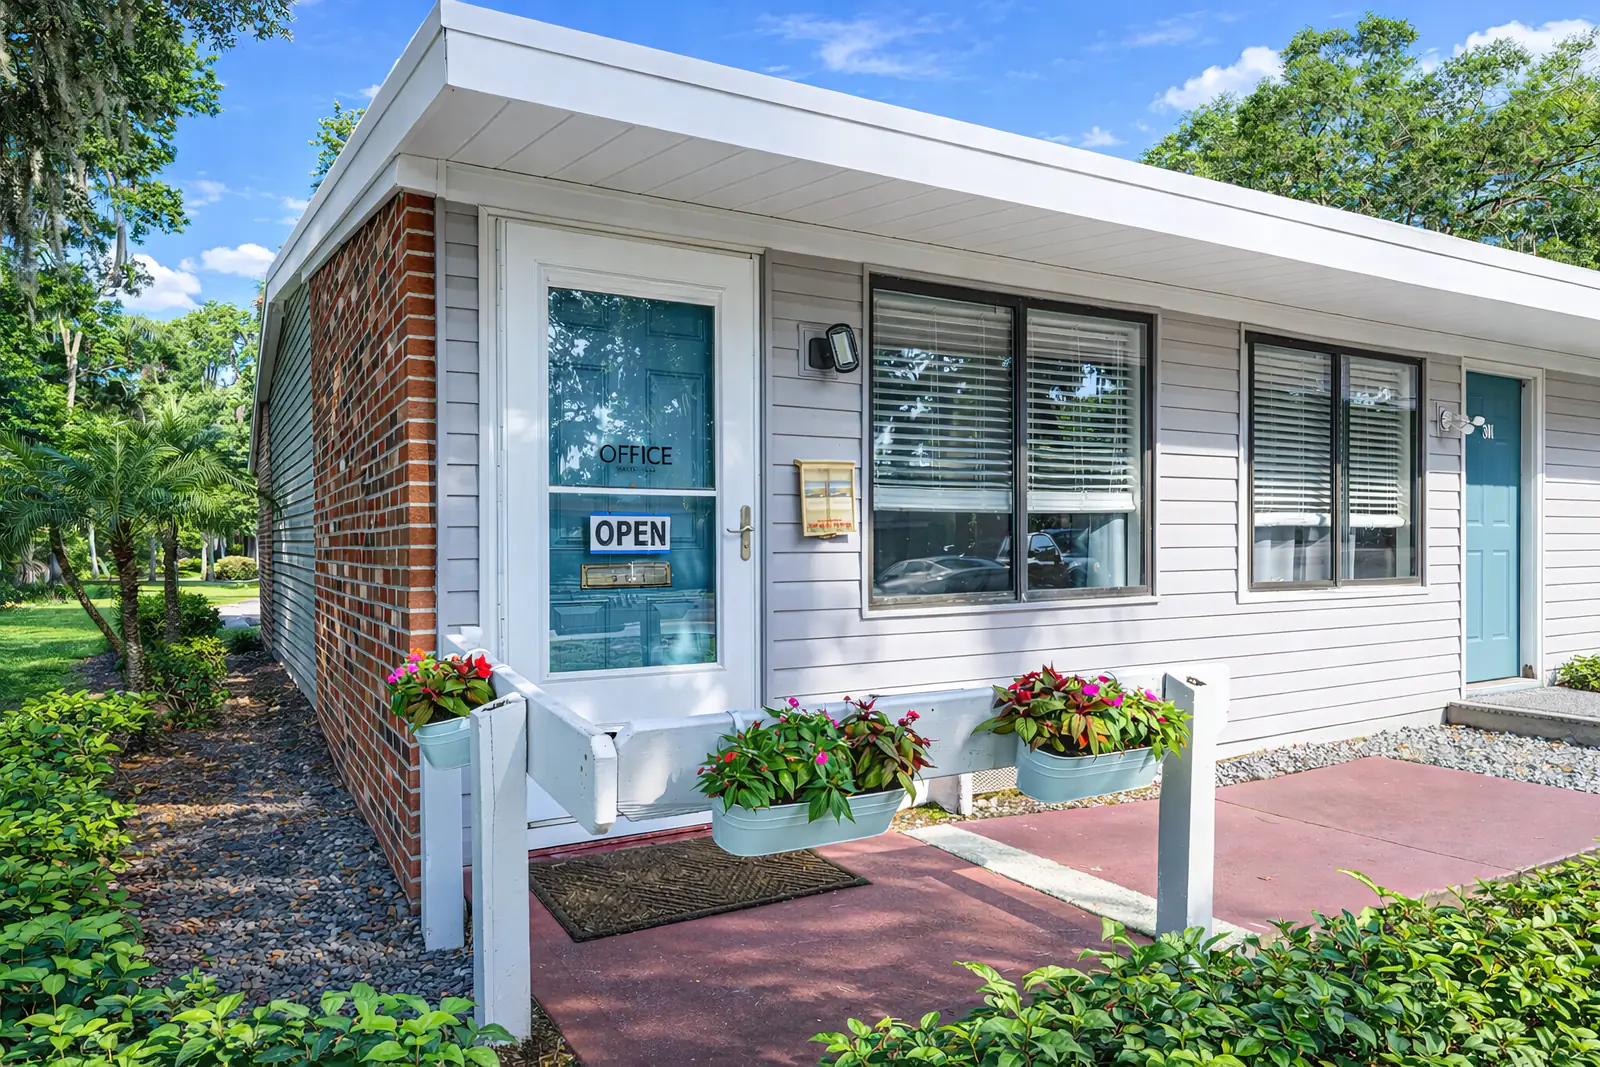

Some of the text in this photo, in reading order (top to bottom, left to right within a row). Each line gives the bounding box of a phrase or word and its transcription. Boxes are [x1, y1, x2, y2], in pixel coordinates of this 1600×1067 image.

[1482, 424, 1494, 439] 311
[600, 444, 673, 465] OFFICE
[595, 519, 666, 547] OPEN
